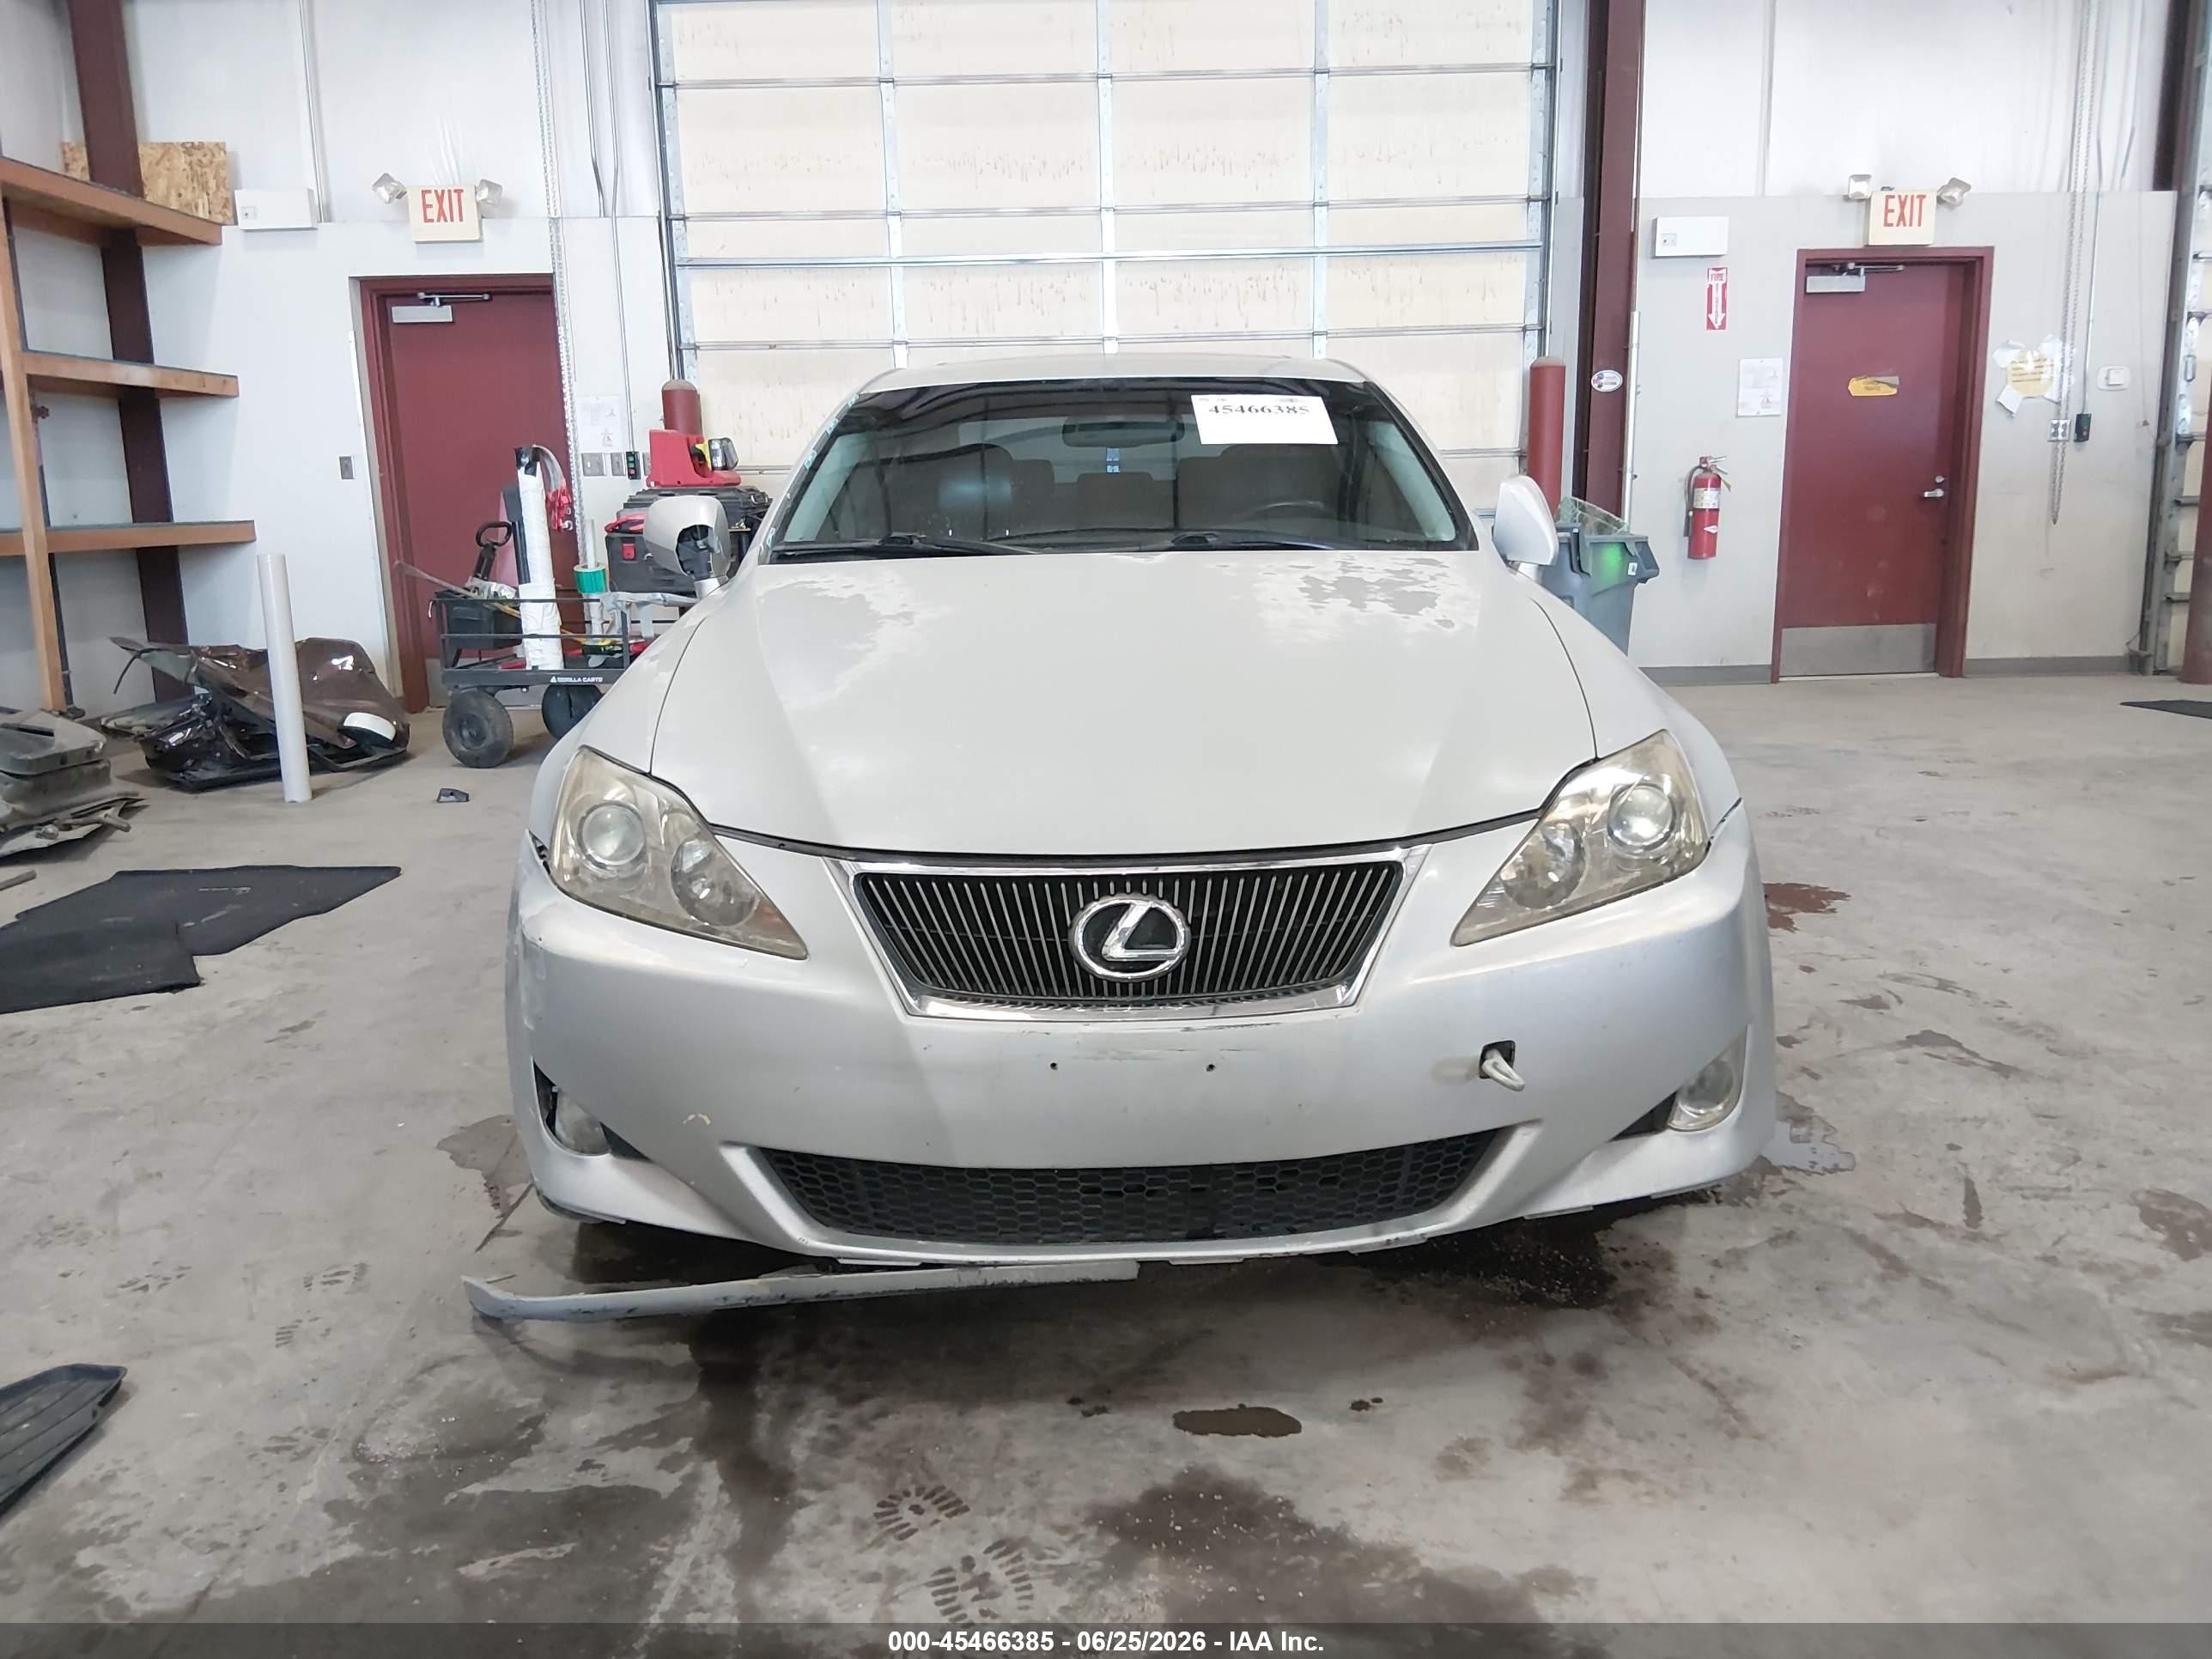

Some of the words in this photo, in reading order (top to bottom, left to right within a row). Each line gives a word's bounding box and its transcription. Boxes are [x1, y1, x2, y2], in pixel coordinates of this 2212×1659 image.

[421, 189, 464, 222] EXIT
[1883, 195, 1926, 228] EXIT
[1711, 273, 1724, 282] FIRE
[1208, 404, 1310, 414] 45466385
